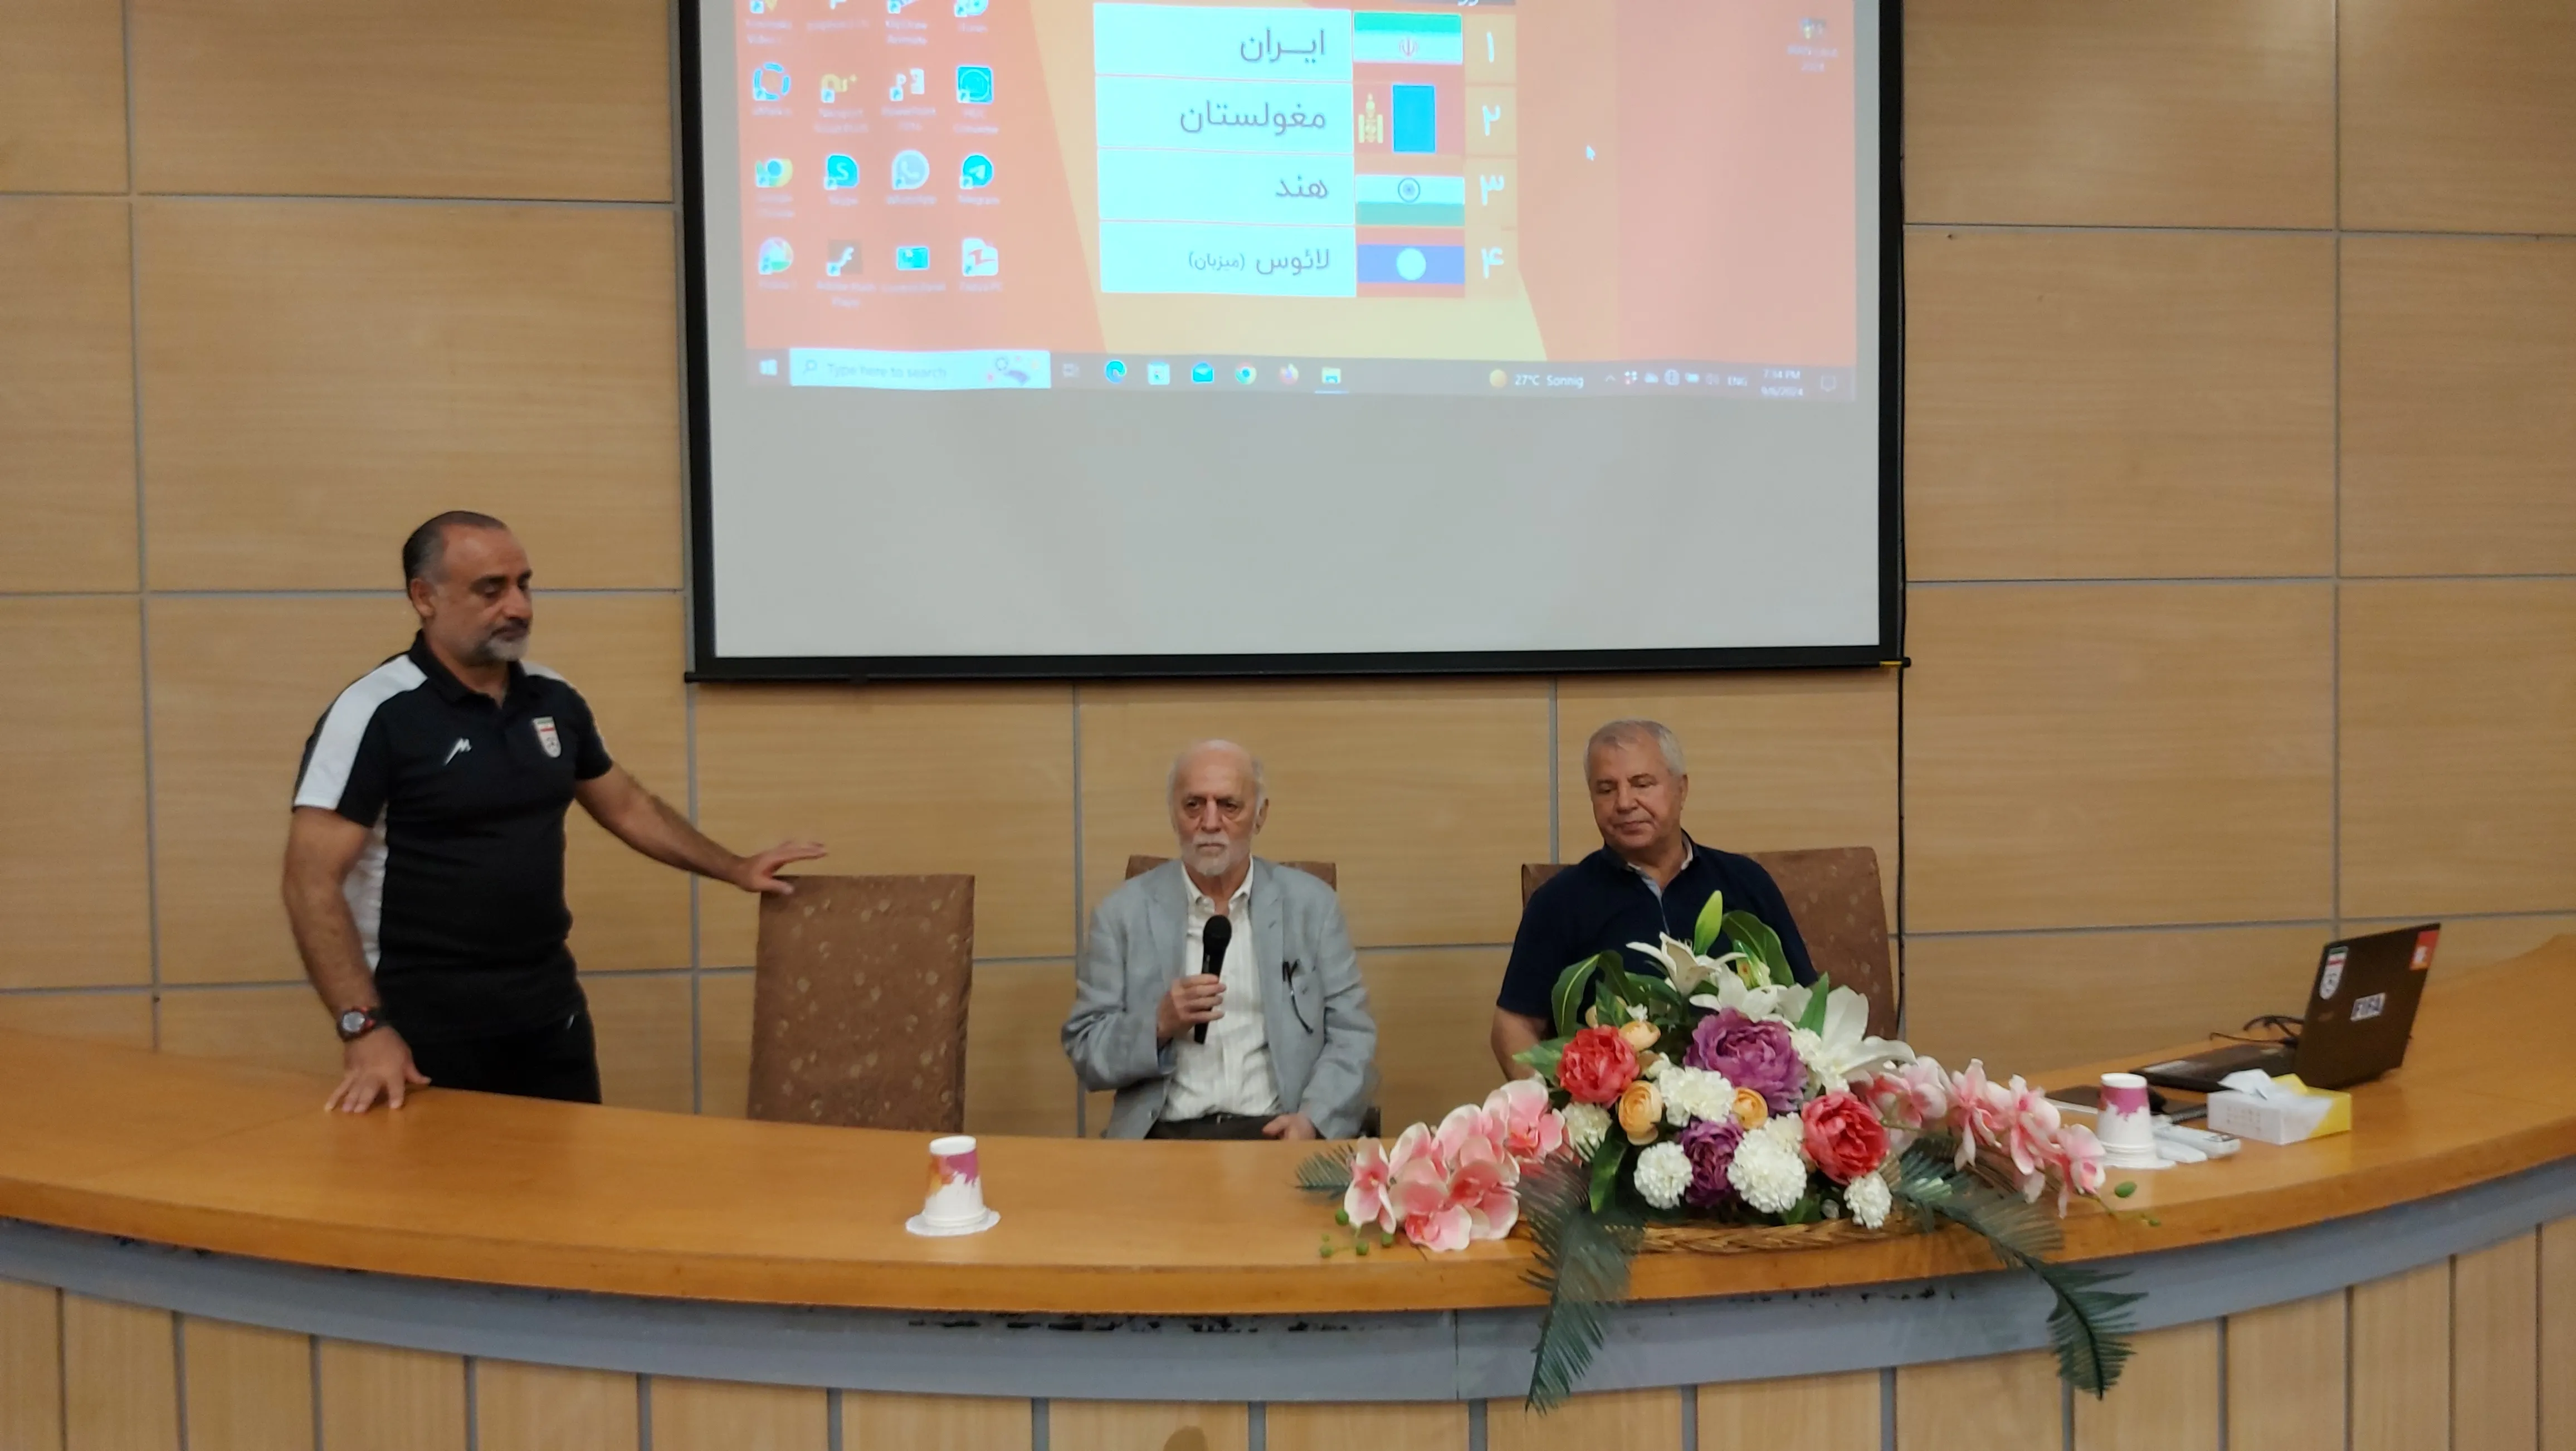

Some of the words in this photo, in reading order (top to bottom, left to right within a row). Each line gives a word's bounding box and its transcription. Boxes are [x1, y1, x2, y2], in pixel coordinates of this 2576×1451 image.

[1240, 28, 1326, 64] ایران
[1180, 99, 1326, 136] مغولستان
[1275, 174, 1329, 199] هند
[1189, 251, 1246, 271] (میزبان)
[1255, 249, 1330, 275] لائوس
[1515, 373, 1540, 386] 27°C
[1546, 374, 1584, 389] Sonnig
